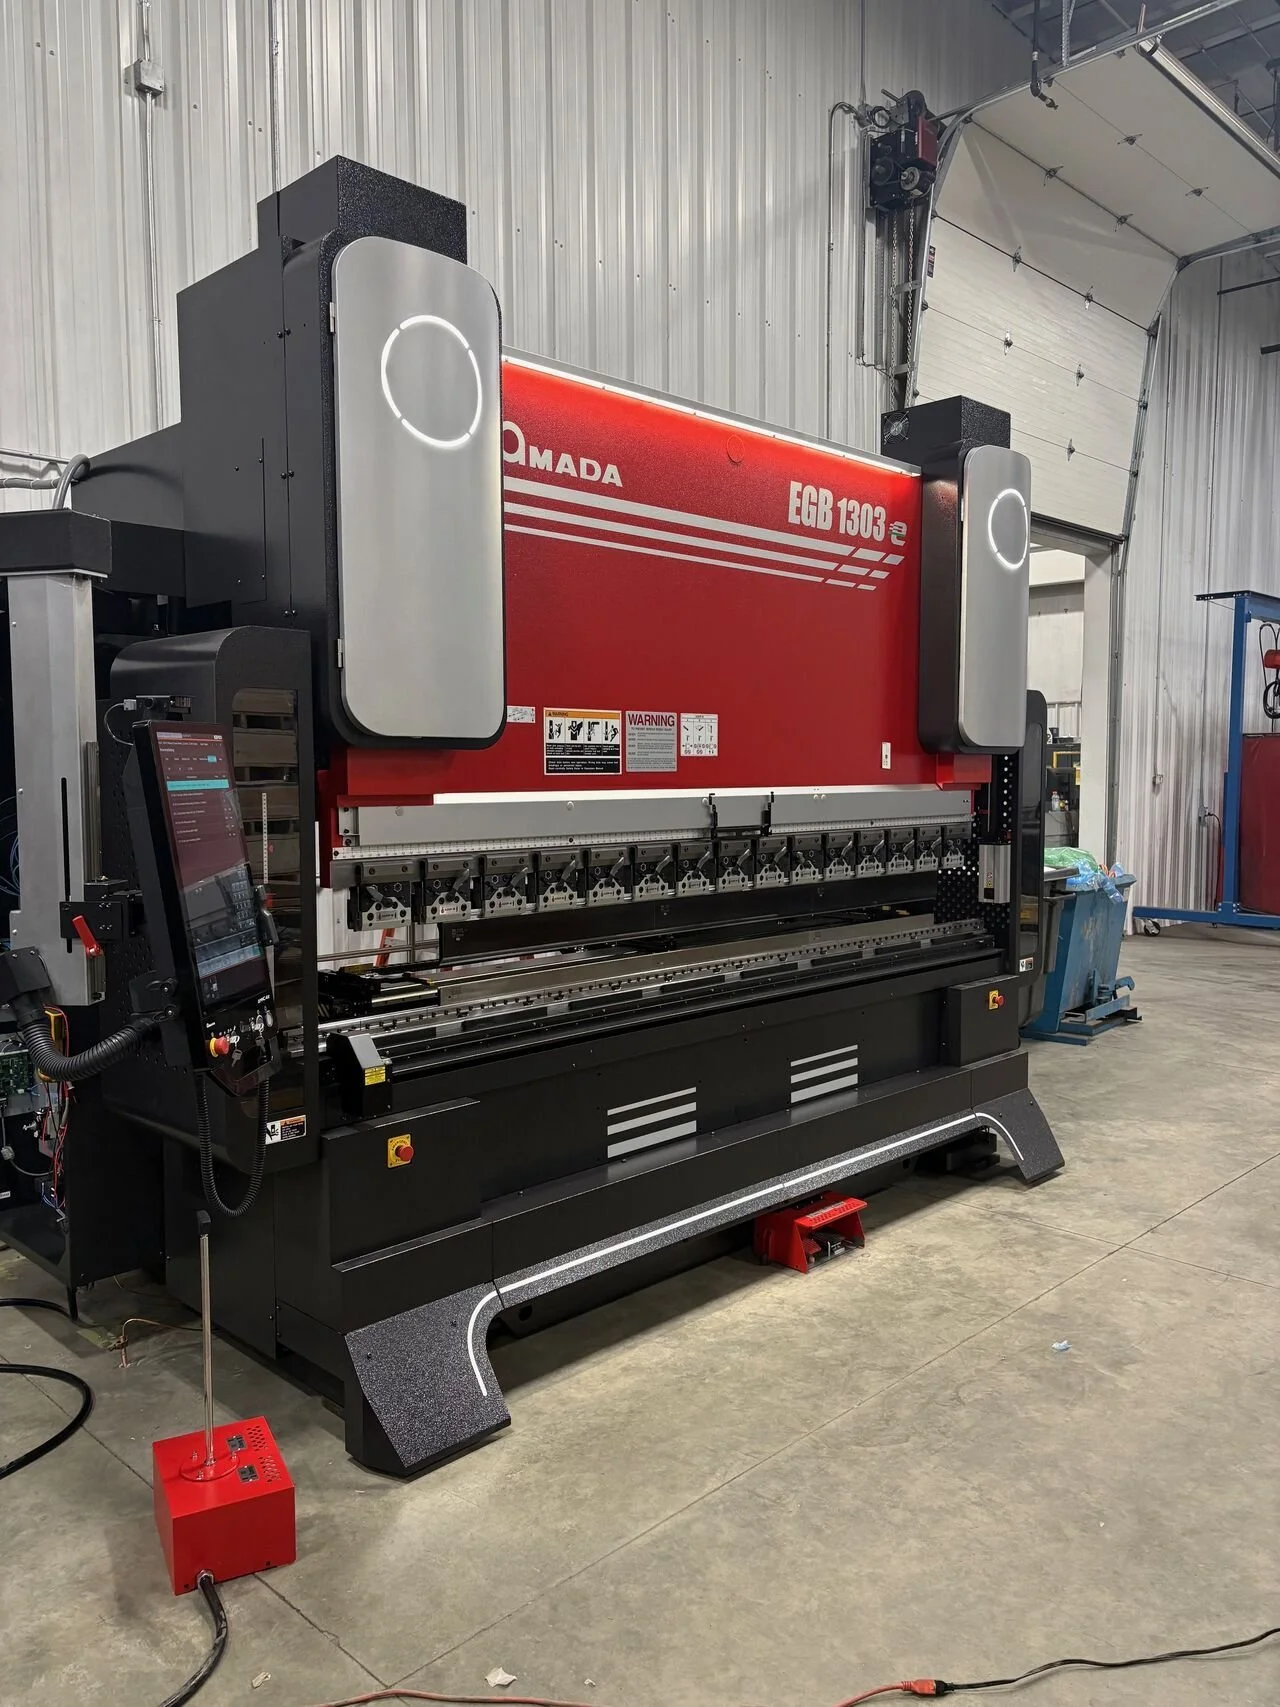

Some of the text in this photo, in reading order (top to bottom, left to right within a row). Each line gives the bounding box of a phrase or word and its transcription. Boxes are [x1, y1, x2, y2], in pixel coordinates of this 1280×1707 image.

[788, 480, 833, 531] EGB
[837, 497, 886, 542] 1303
[627, 713, 675, 727] WARNING
